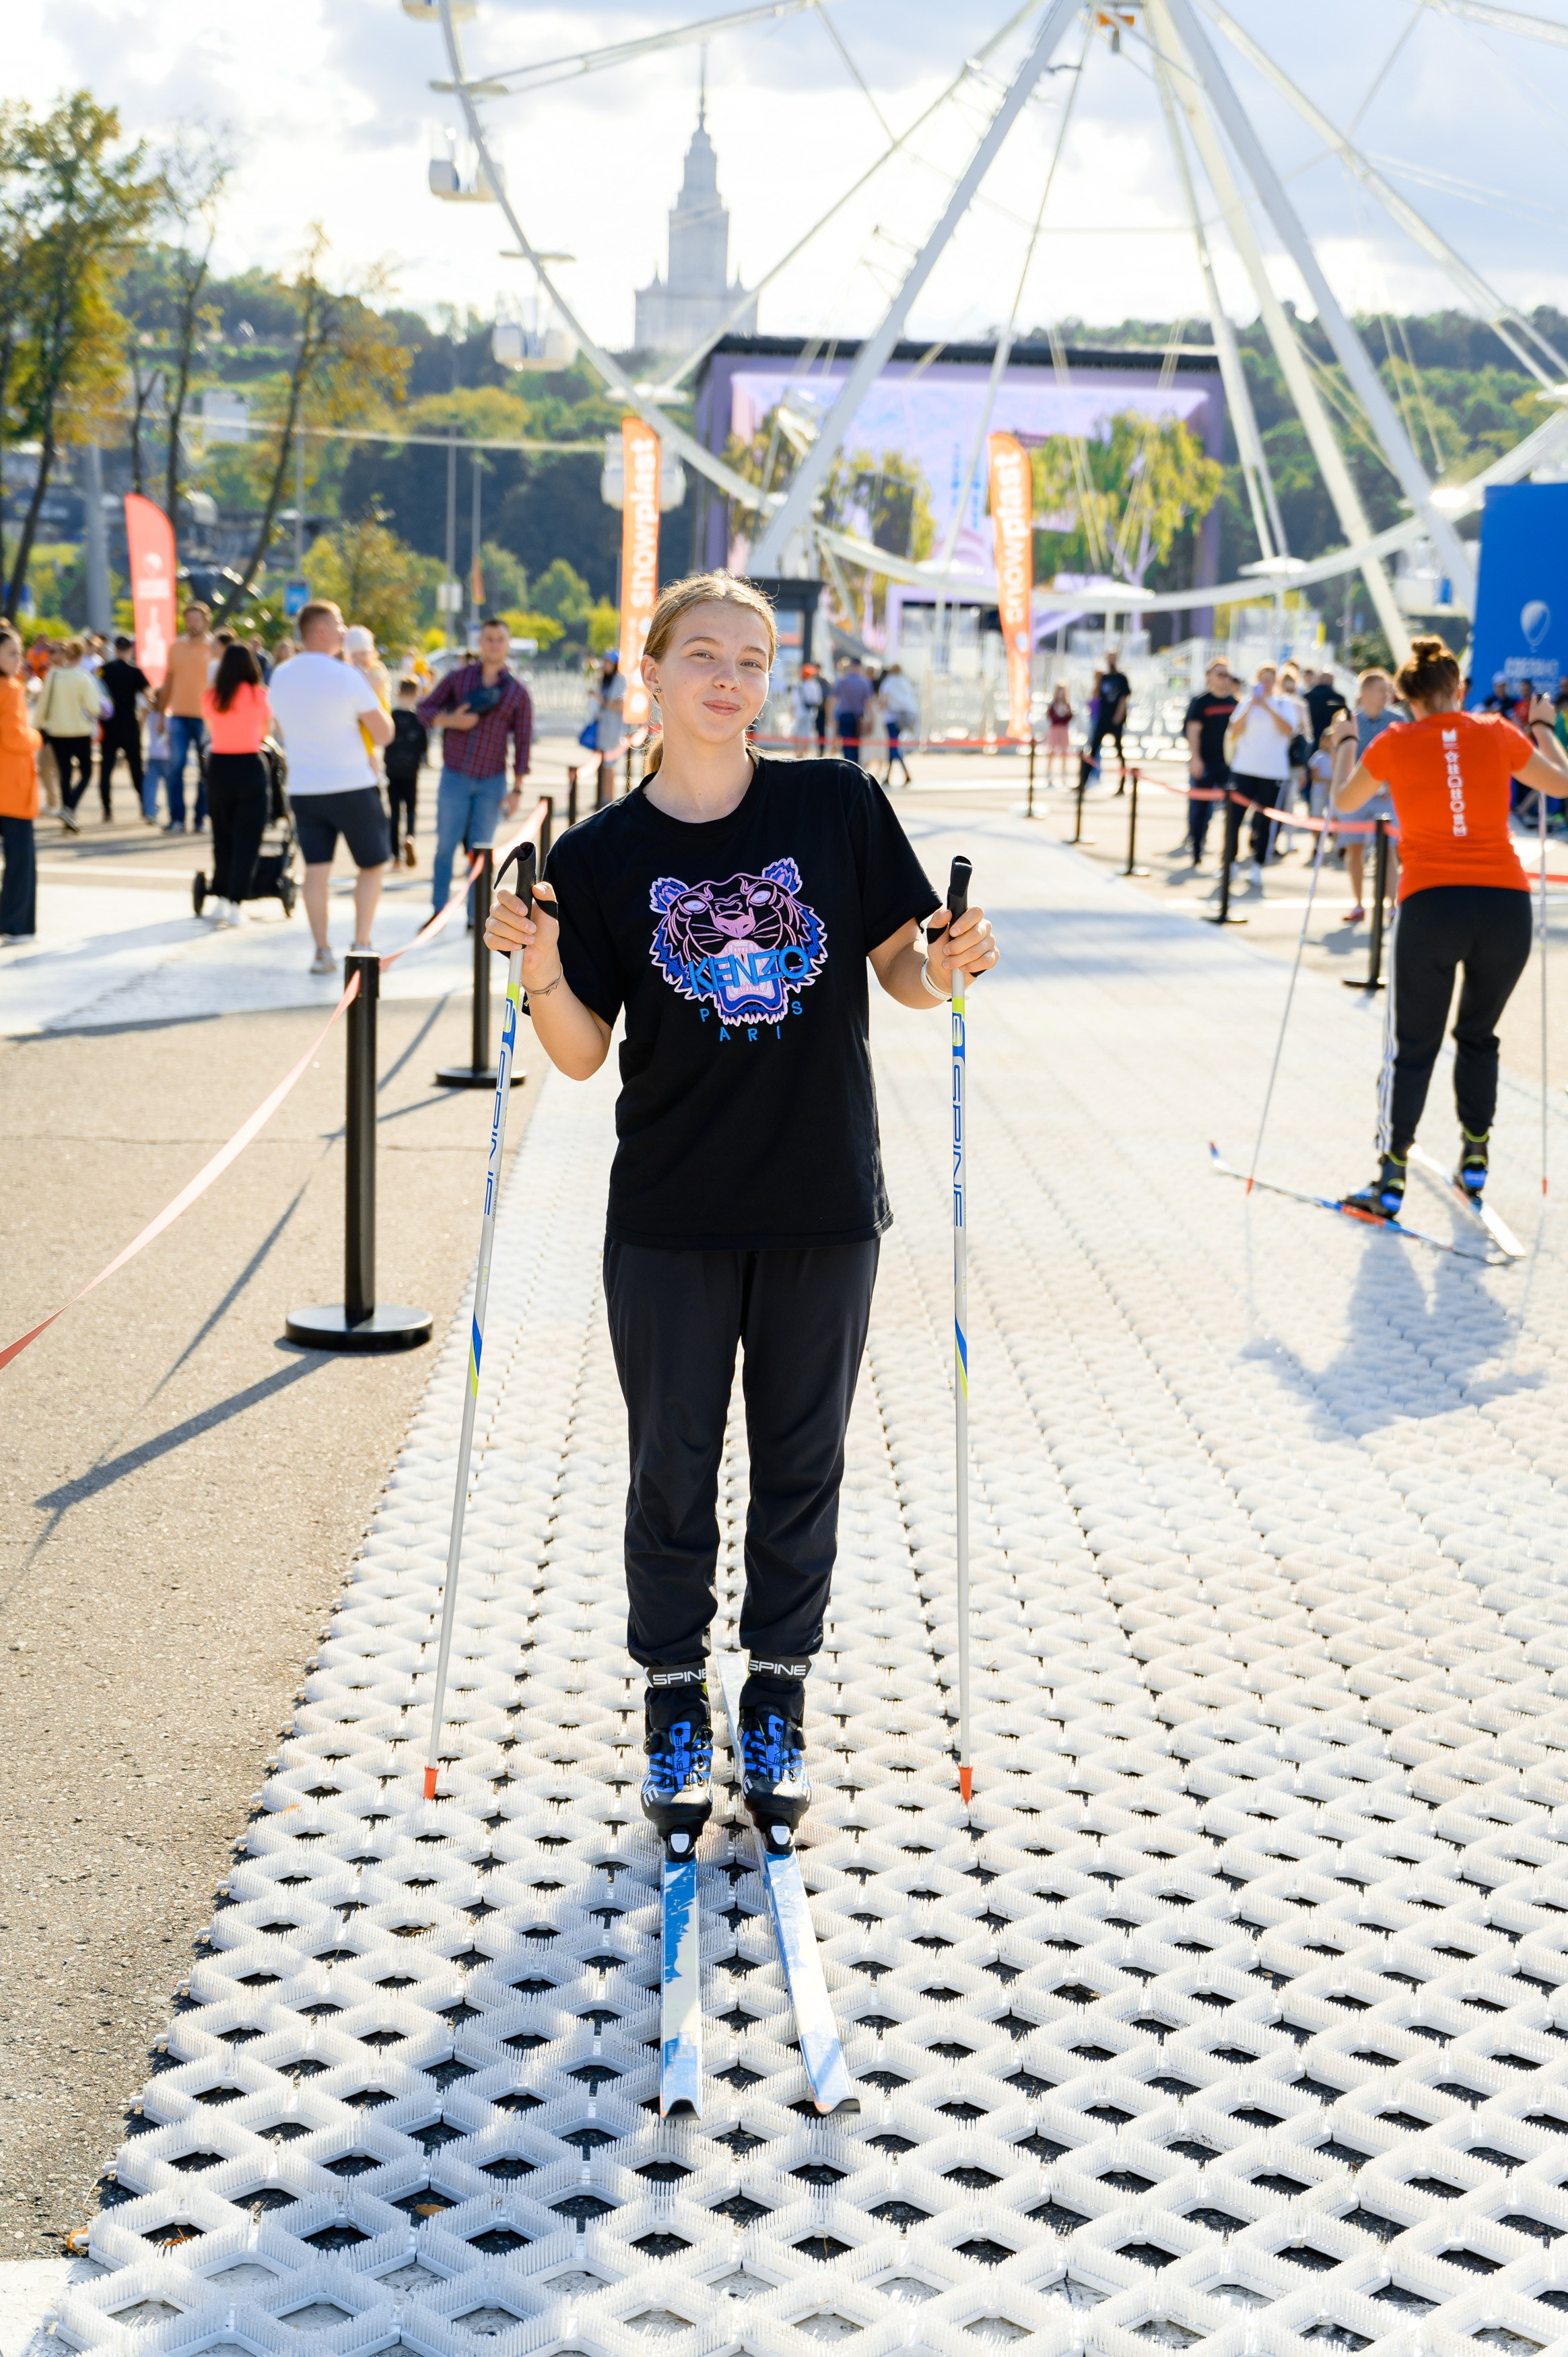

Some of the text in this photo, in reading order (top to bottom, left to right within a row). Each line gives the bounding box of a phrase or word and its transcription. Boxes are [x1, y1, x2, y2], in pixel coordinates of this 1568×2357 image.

[629, 438, 658, 609] snowplast
[994, 451, 1030, 624] snowplast
[687, 945, 808, 995] KENZO
[953, 1065, 962, 1227] SPINE
[652, 1668, 706, 1686] SPINE
[749, 1659, 806, 1676] SPINE
